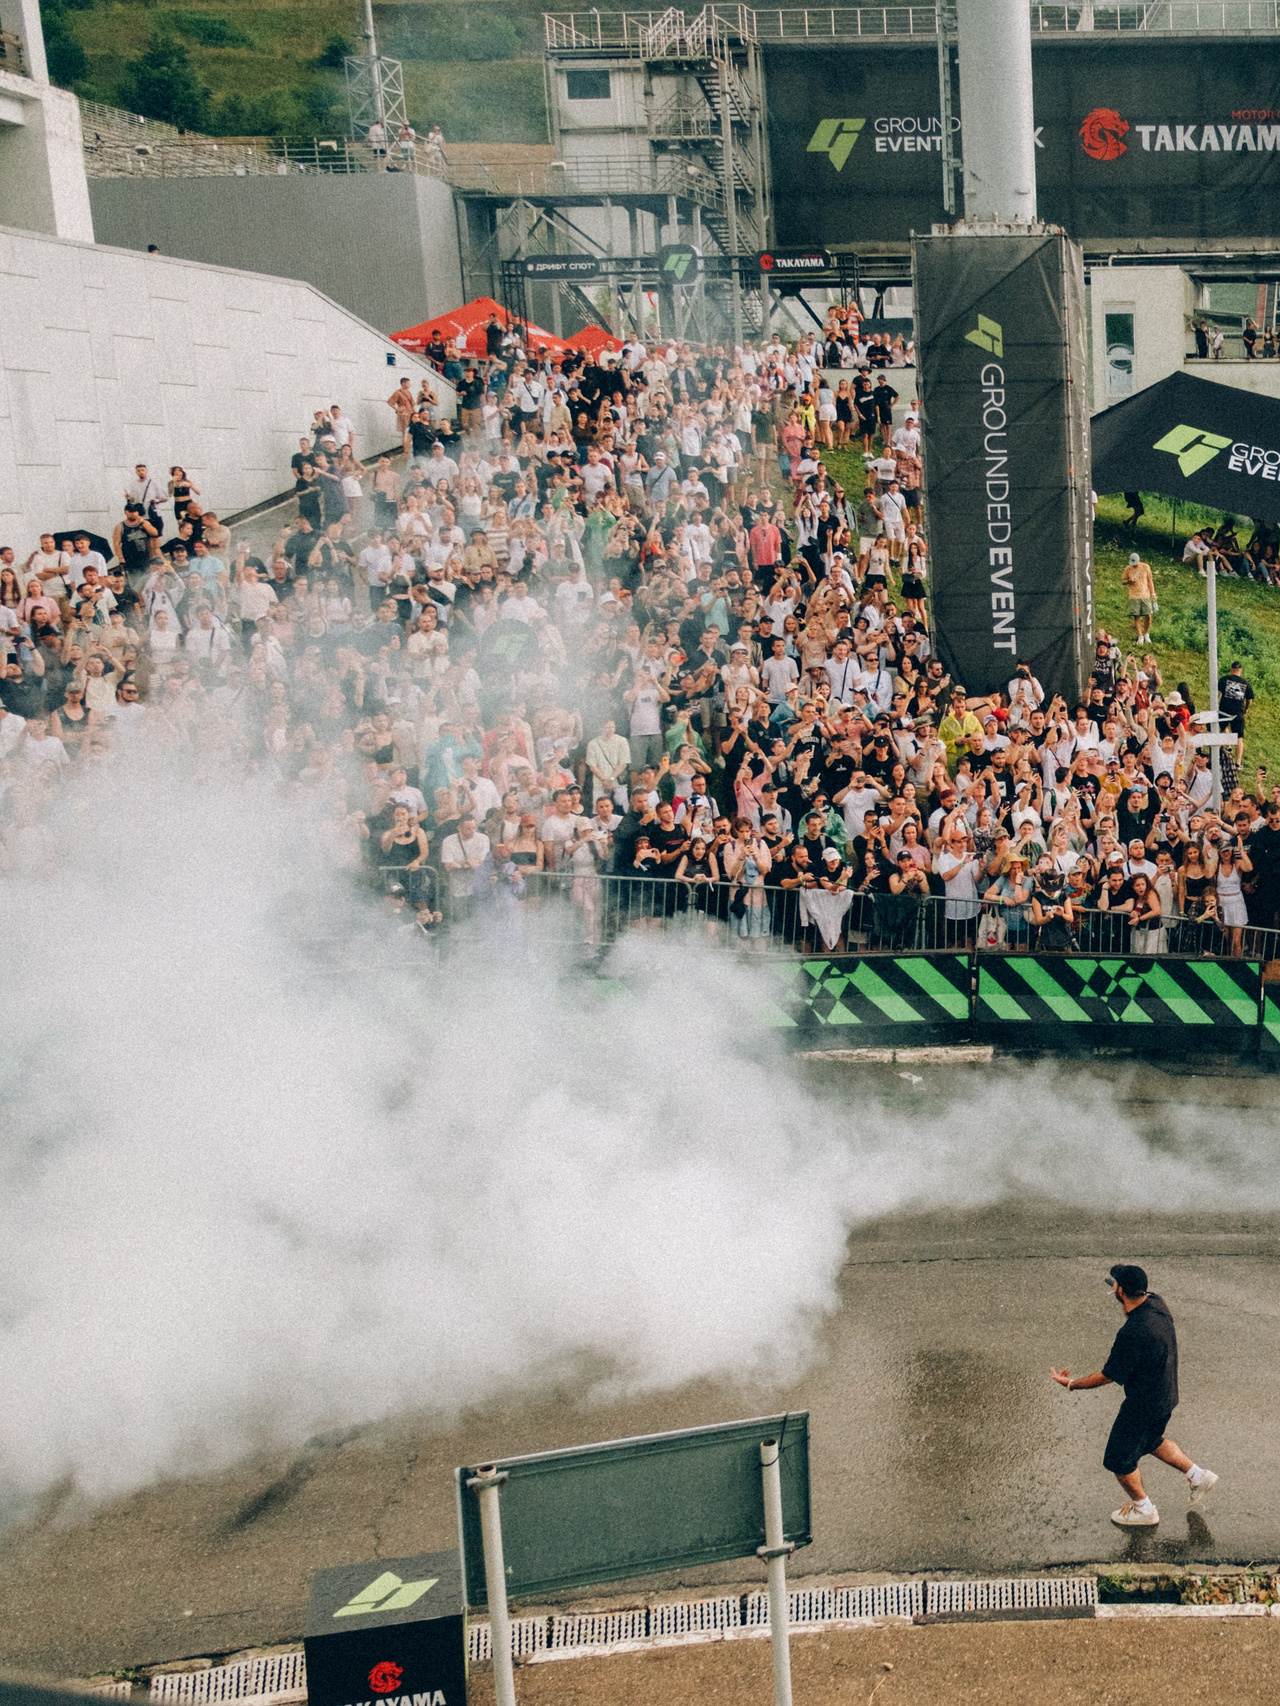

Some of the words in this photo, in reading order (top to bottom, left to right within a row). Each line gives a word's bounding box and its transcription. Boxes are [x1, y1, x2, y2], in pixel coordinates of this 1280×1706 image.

[1231, 109, 1274, 120] MOTOR
[874, 116, 961, 134] GROUND
[775, 258, 825, 268] TAKAYAMA
